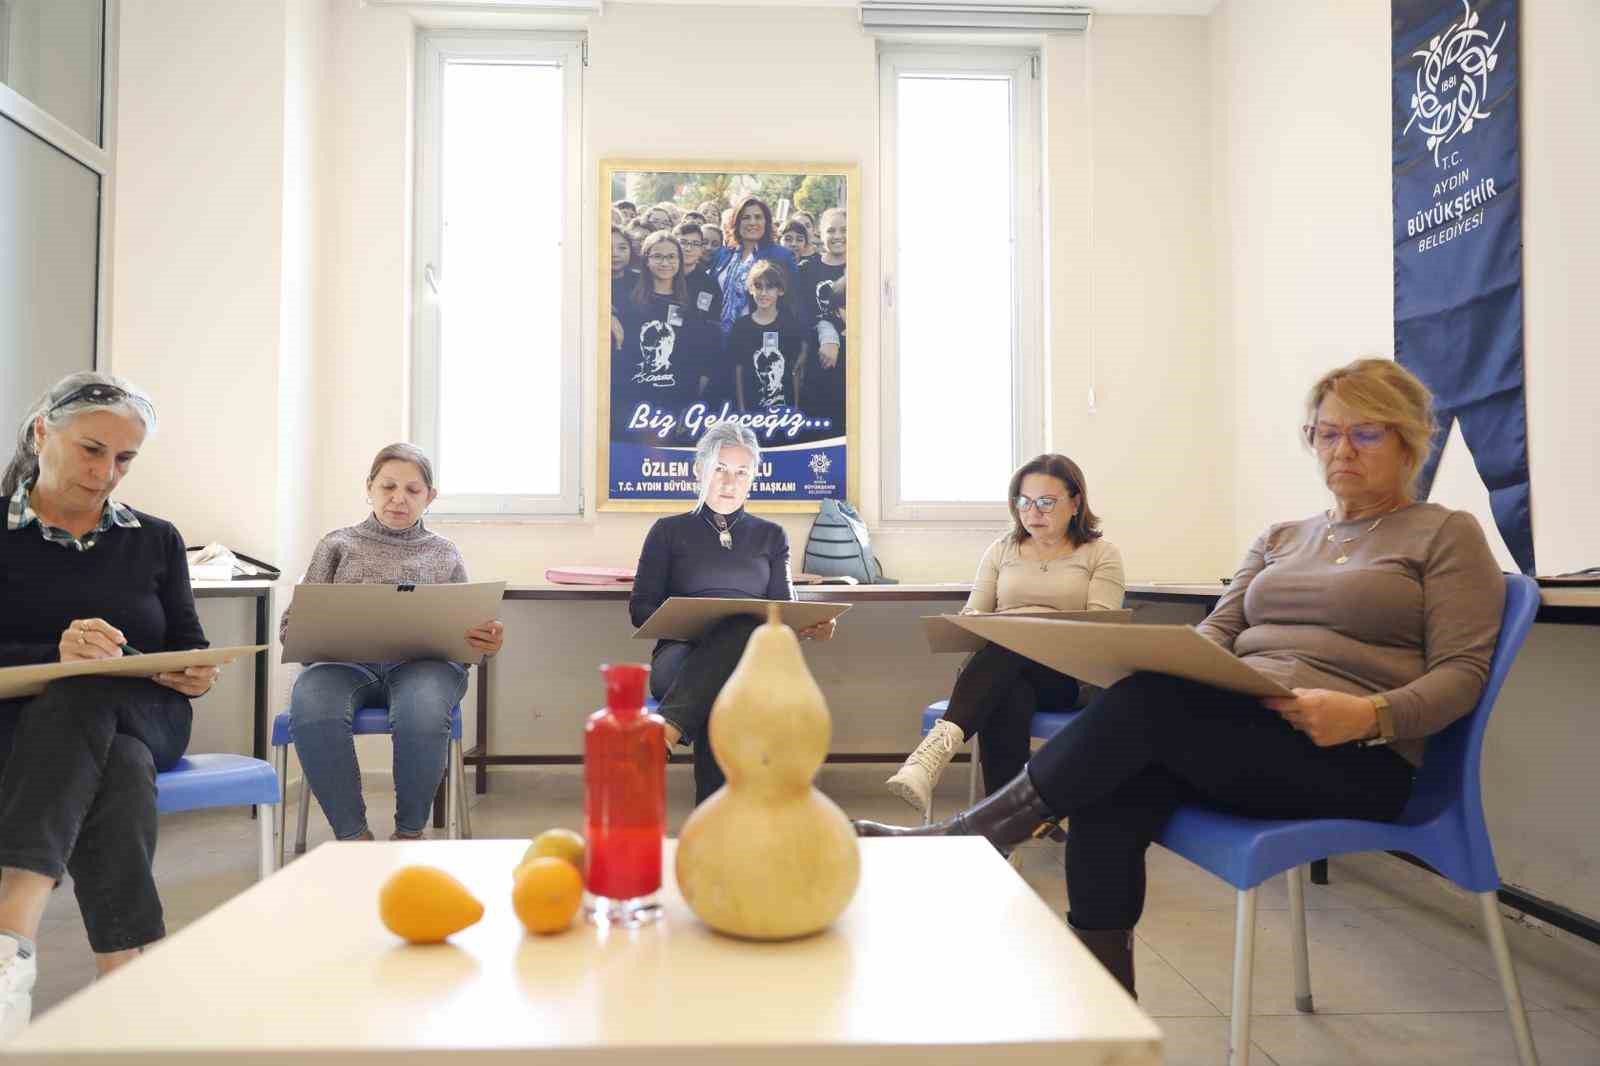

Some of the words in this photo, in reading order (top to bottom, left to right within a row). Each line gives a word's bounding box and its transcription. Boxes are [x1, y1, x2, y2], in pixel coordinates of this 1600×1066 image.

[1441, 151, 1463, 170] T.C.
[1432, 168, 1470, 198] AYDIN
[1407, 177, 1497, 237] BÜYÜKŞEHİR
[1418, 207, 1484, 253] BELEDİYESİ
[628, 403, 676, 438] Biz
[684, 402, 830, 437] Geleceğiz...
[641, 458, 689, 477] ÖZLEM
[618, 481, 635, 492] T.C.
[636, 481, 662, 492] AYDIN
[759, 481, 796, 494] BAŞKANI
